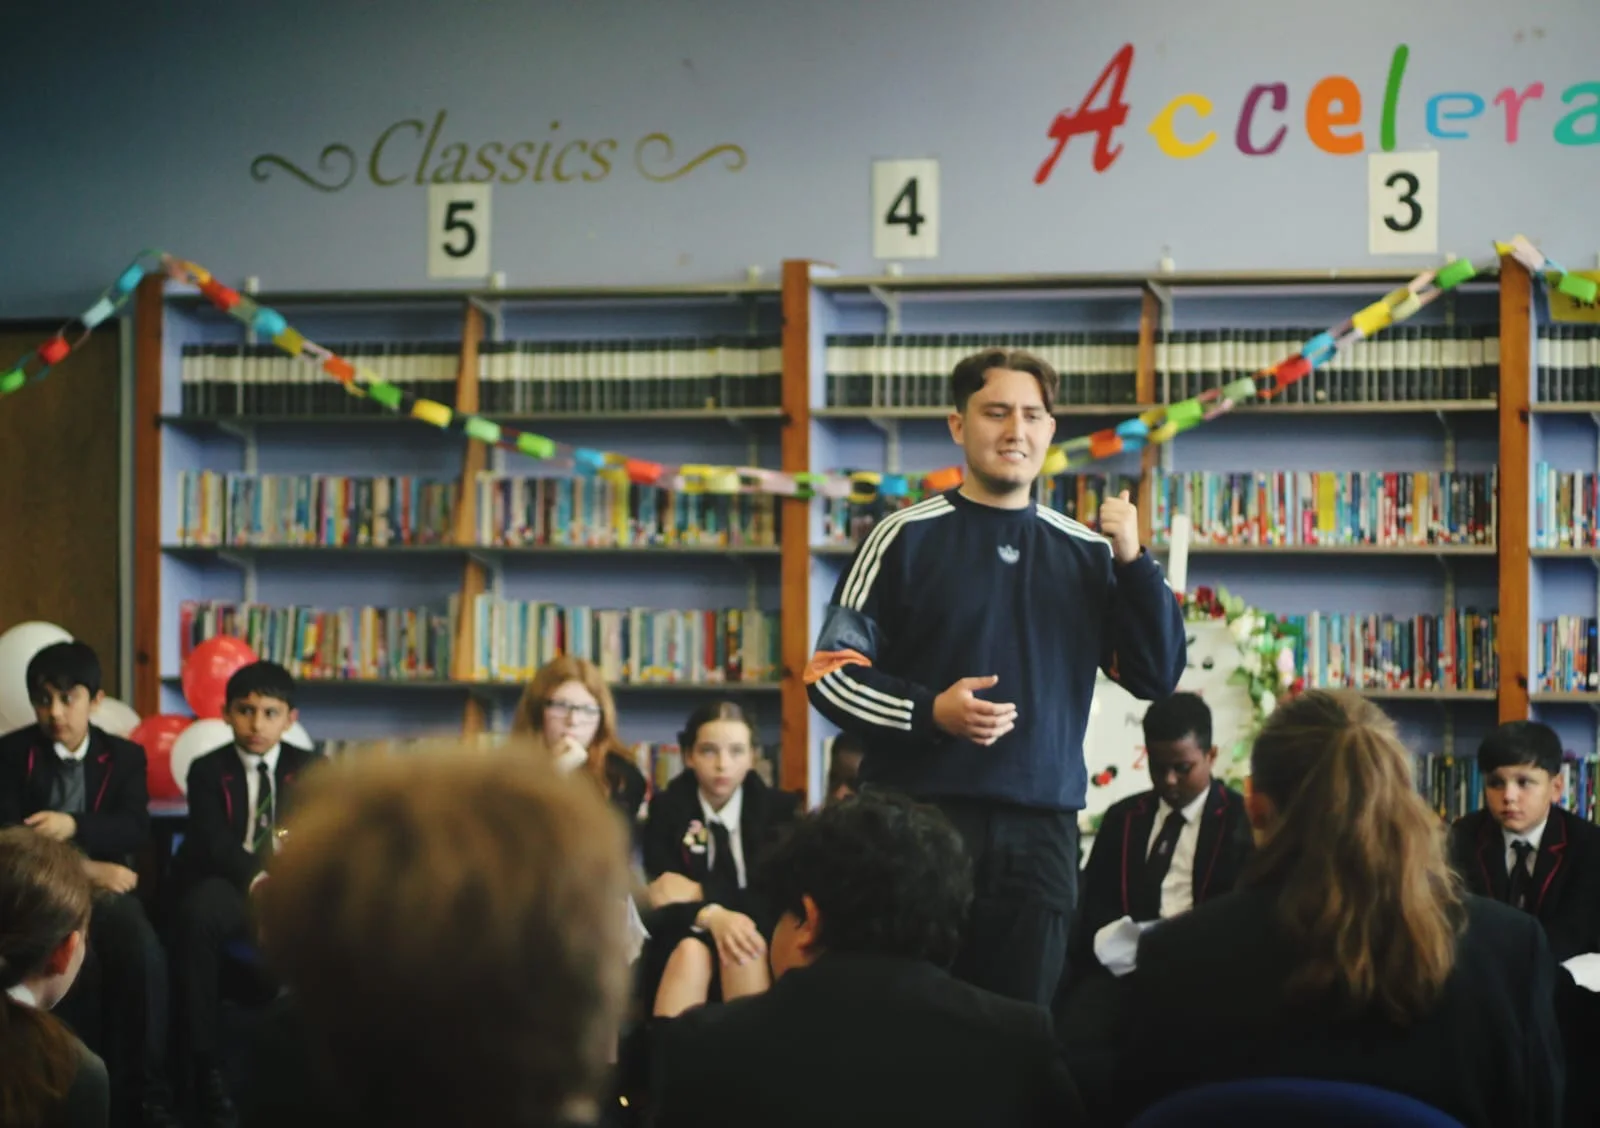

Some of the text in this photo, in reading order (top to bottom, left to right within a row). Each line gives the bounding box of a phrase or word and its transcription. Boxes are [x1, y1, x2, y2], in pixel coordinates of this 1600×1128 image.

[1033, 43, 1600, 185] Accelera
[367, 109, 618, 187] Classics
[443, 201, 476, 258] 5
[885, 177, 925, 236] 4
[1383, 170, 1423, 232] 3
